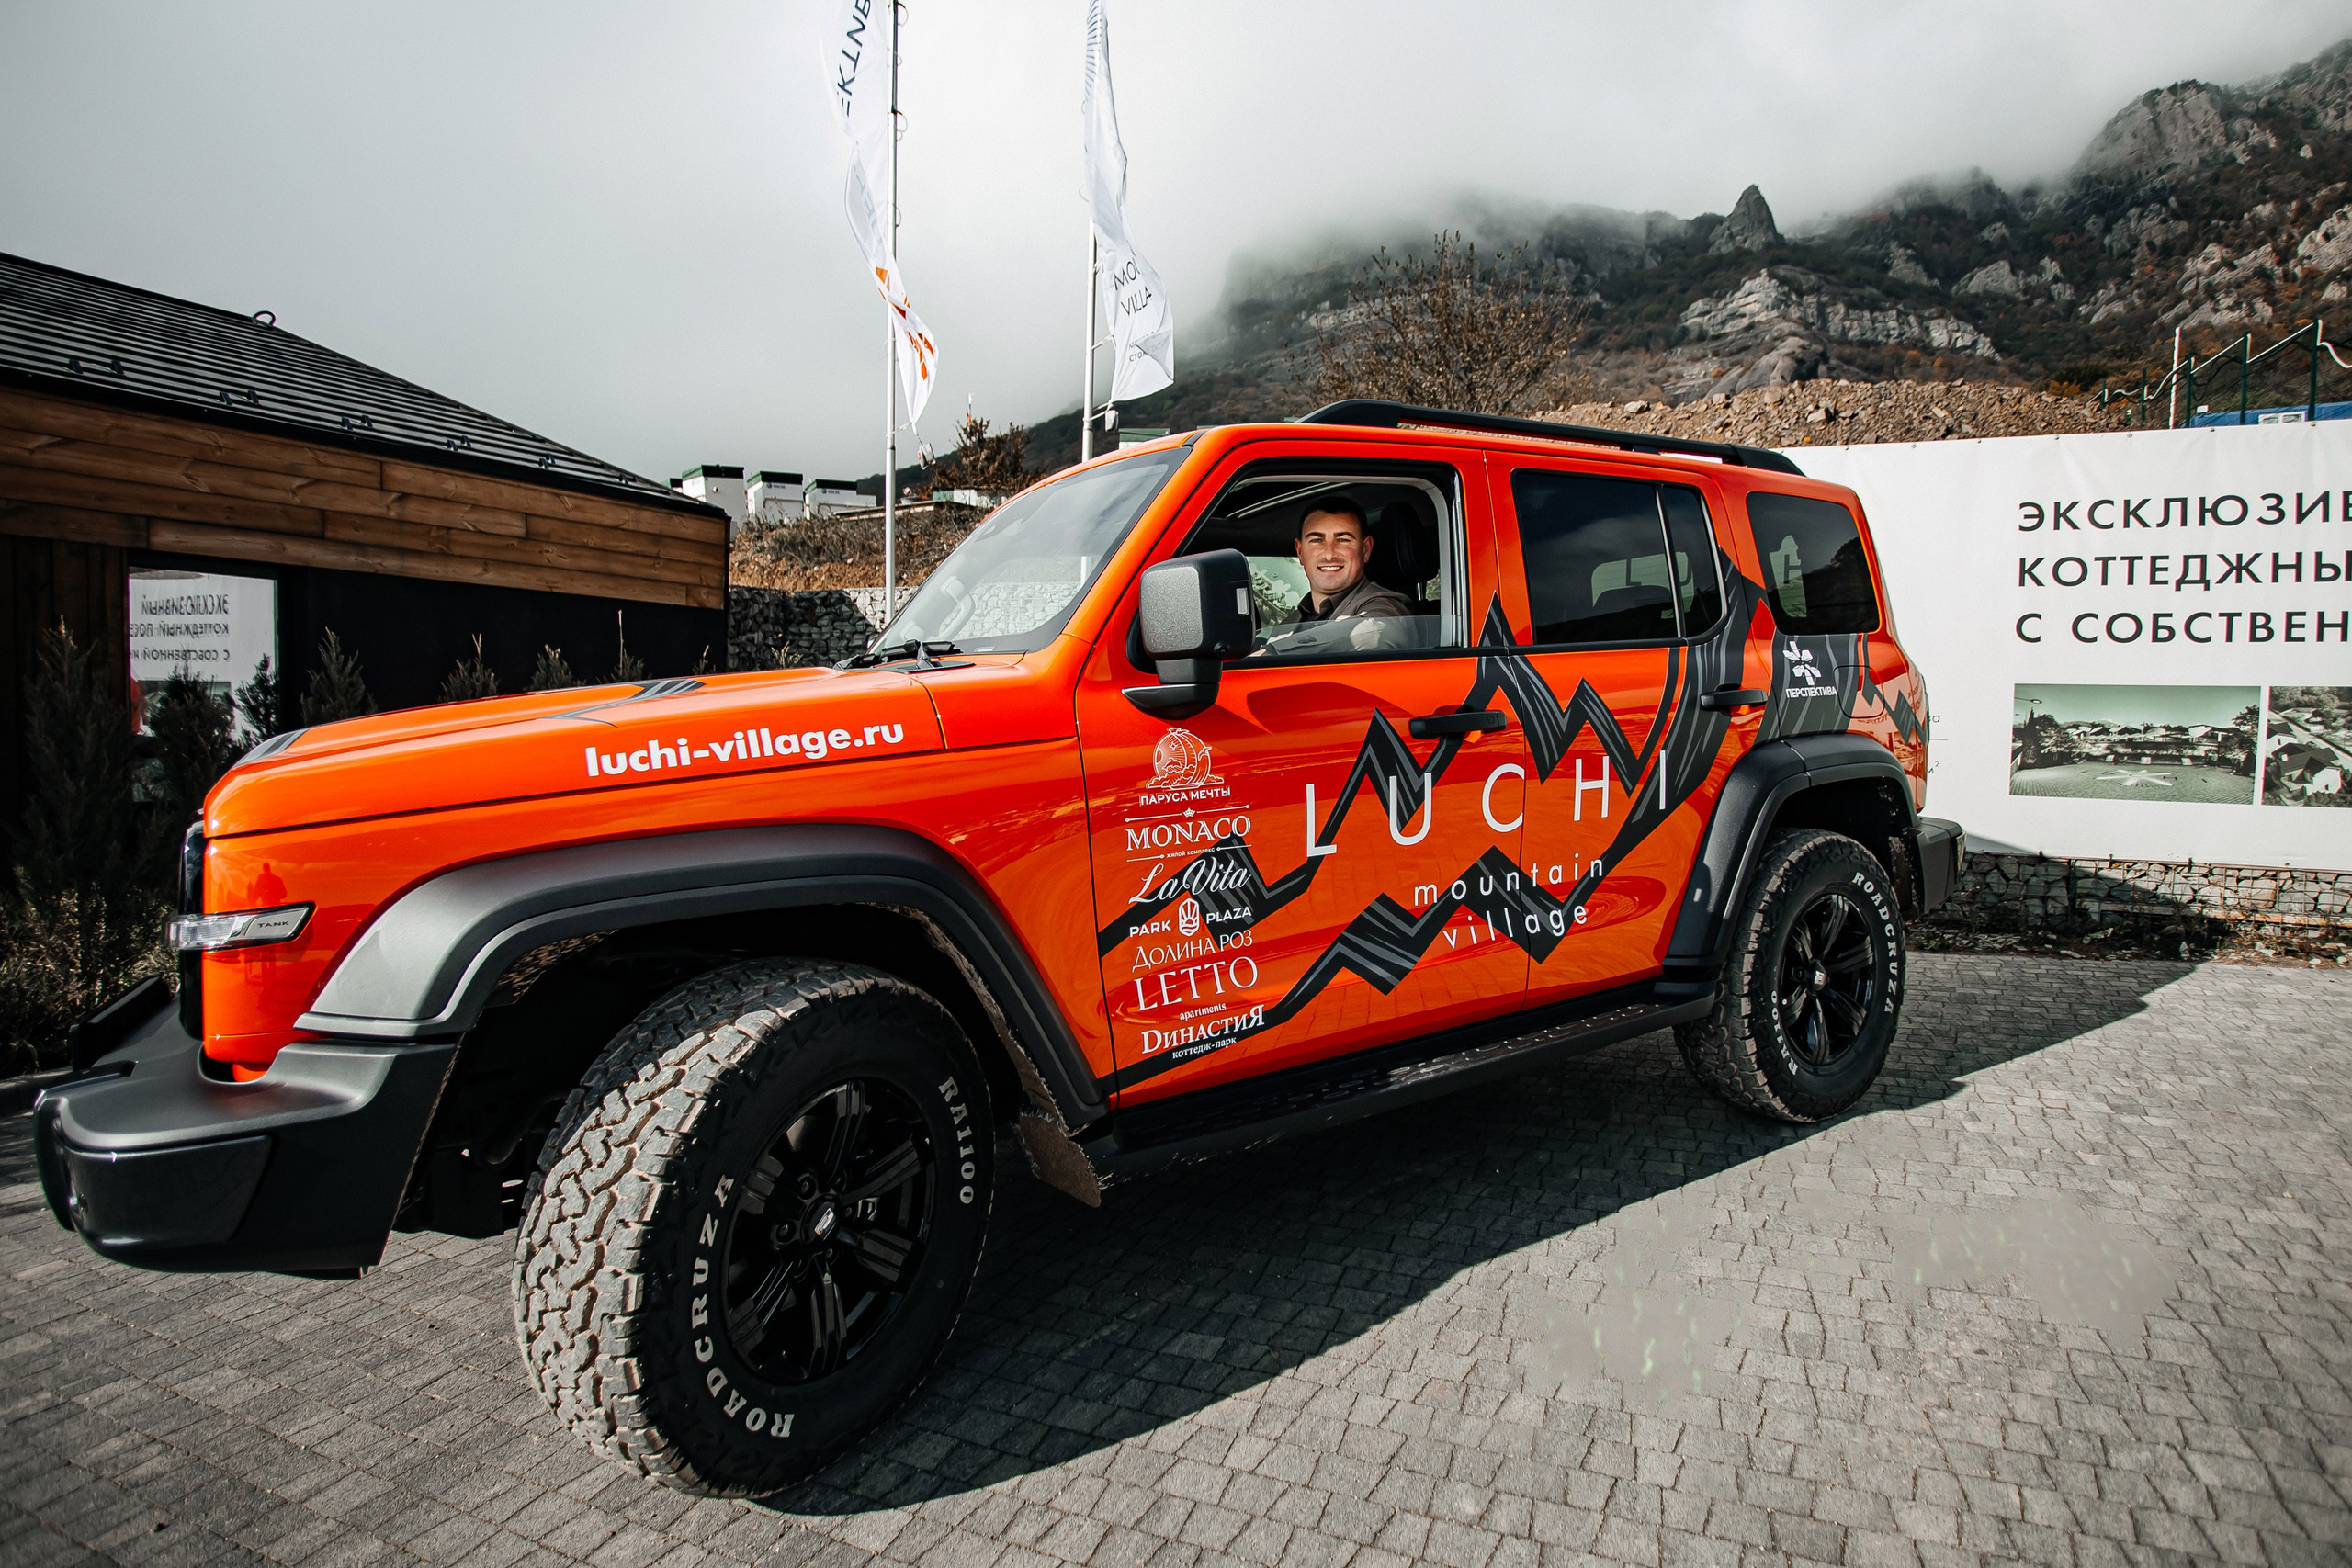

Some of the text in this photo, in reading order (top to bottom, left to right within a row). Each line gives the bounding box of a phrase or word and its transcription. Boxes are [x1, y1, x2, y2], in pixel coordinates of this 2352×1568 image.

[2018, 550, 2352, 592] КОТТЕДЖНЫ
[2016, 610, 2348, 644] С СОБСТВЕН
[1786, 685, 1837, 698] ПЕРСПЕКТИВА
[584, 723, 904, 777] luchi-village.ru
[1140, 787, 1230, 806] ПАРУСА МЕЧТЫ
[1306, 750, 1667, 858] LUCHI
[1125, 815, 1251, 852] MONACO
[1414, 852, 1603, 907] mountain
[1129, 906, 1252, 938] PARK PLAZA
[1442, 904, 1589, 949] village
[1851, 872, 1898, 1014] ROADCRUZA
[1132, 929, 1253, 973] ДОЛИНА РОЗ
[1134, 956, 1259, 1011] LETTO
[1179, 1002, 1227, 1021] apartments
[1172, 1036, 1237, 1059] коттедж-парк
[938, 1076, 975, 1204] RA1100
[692, 1174, 795, 1438] ROADCRUZA
